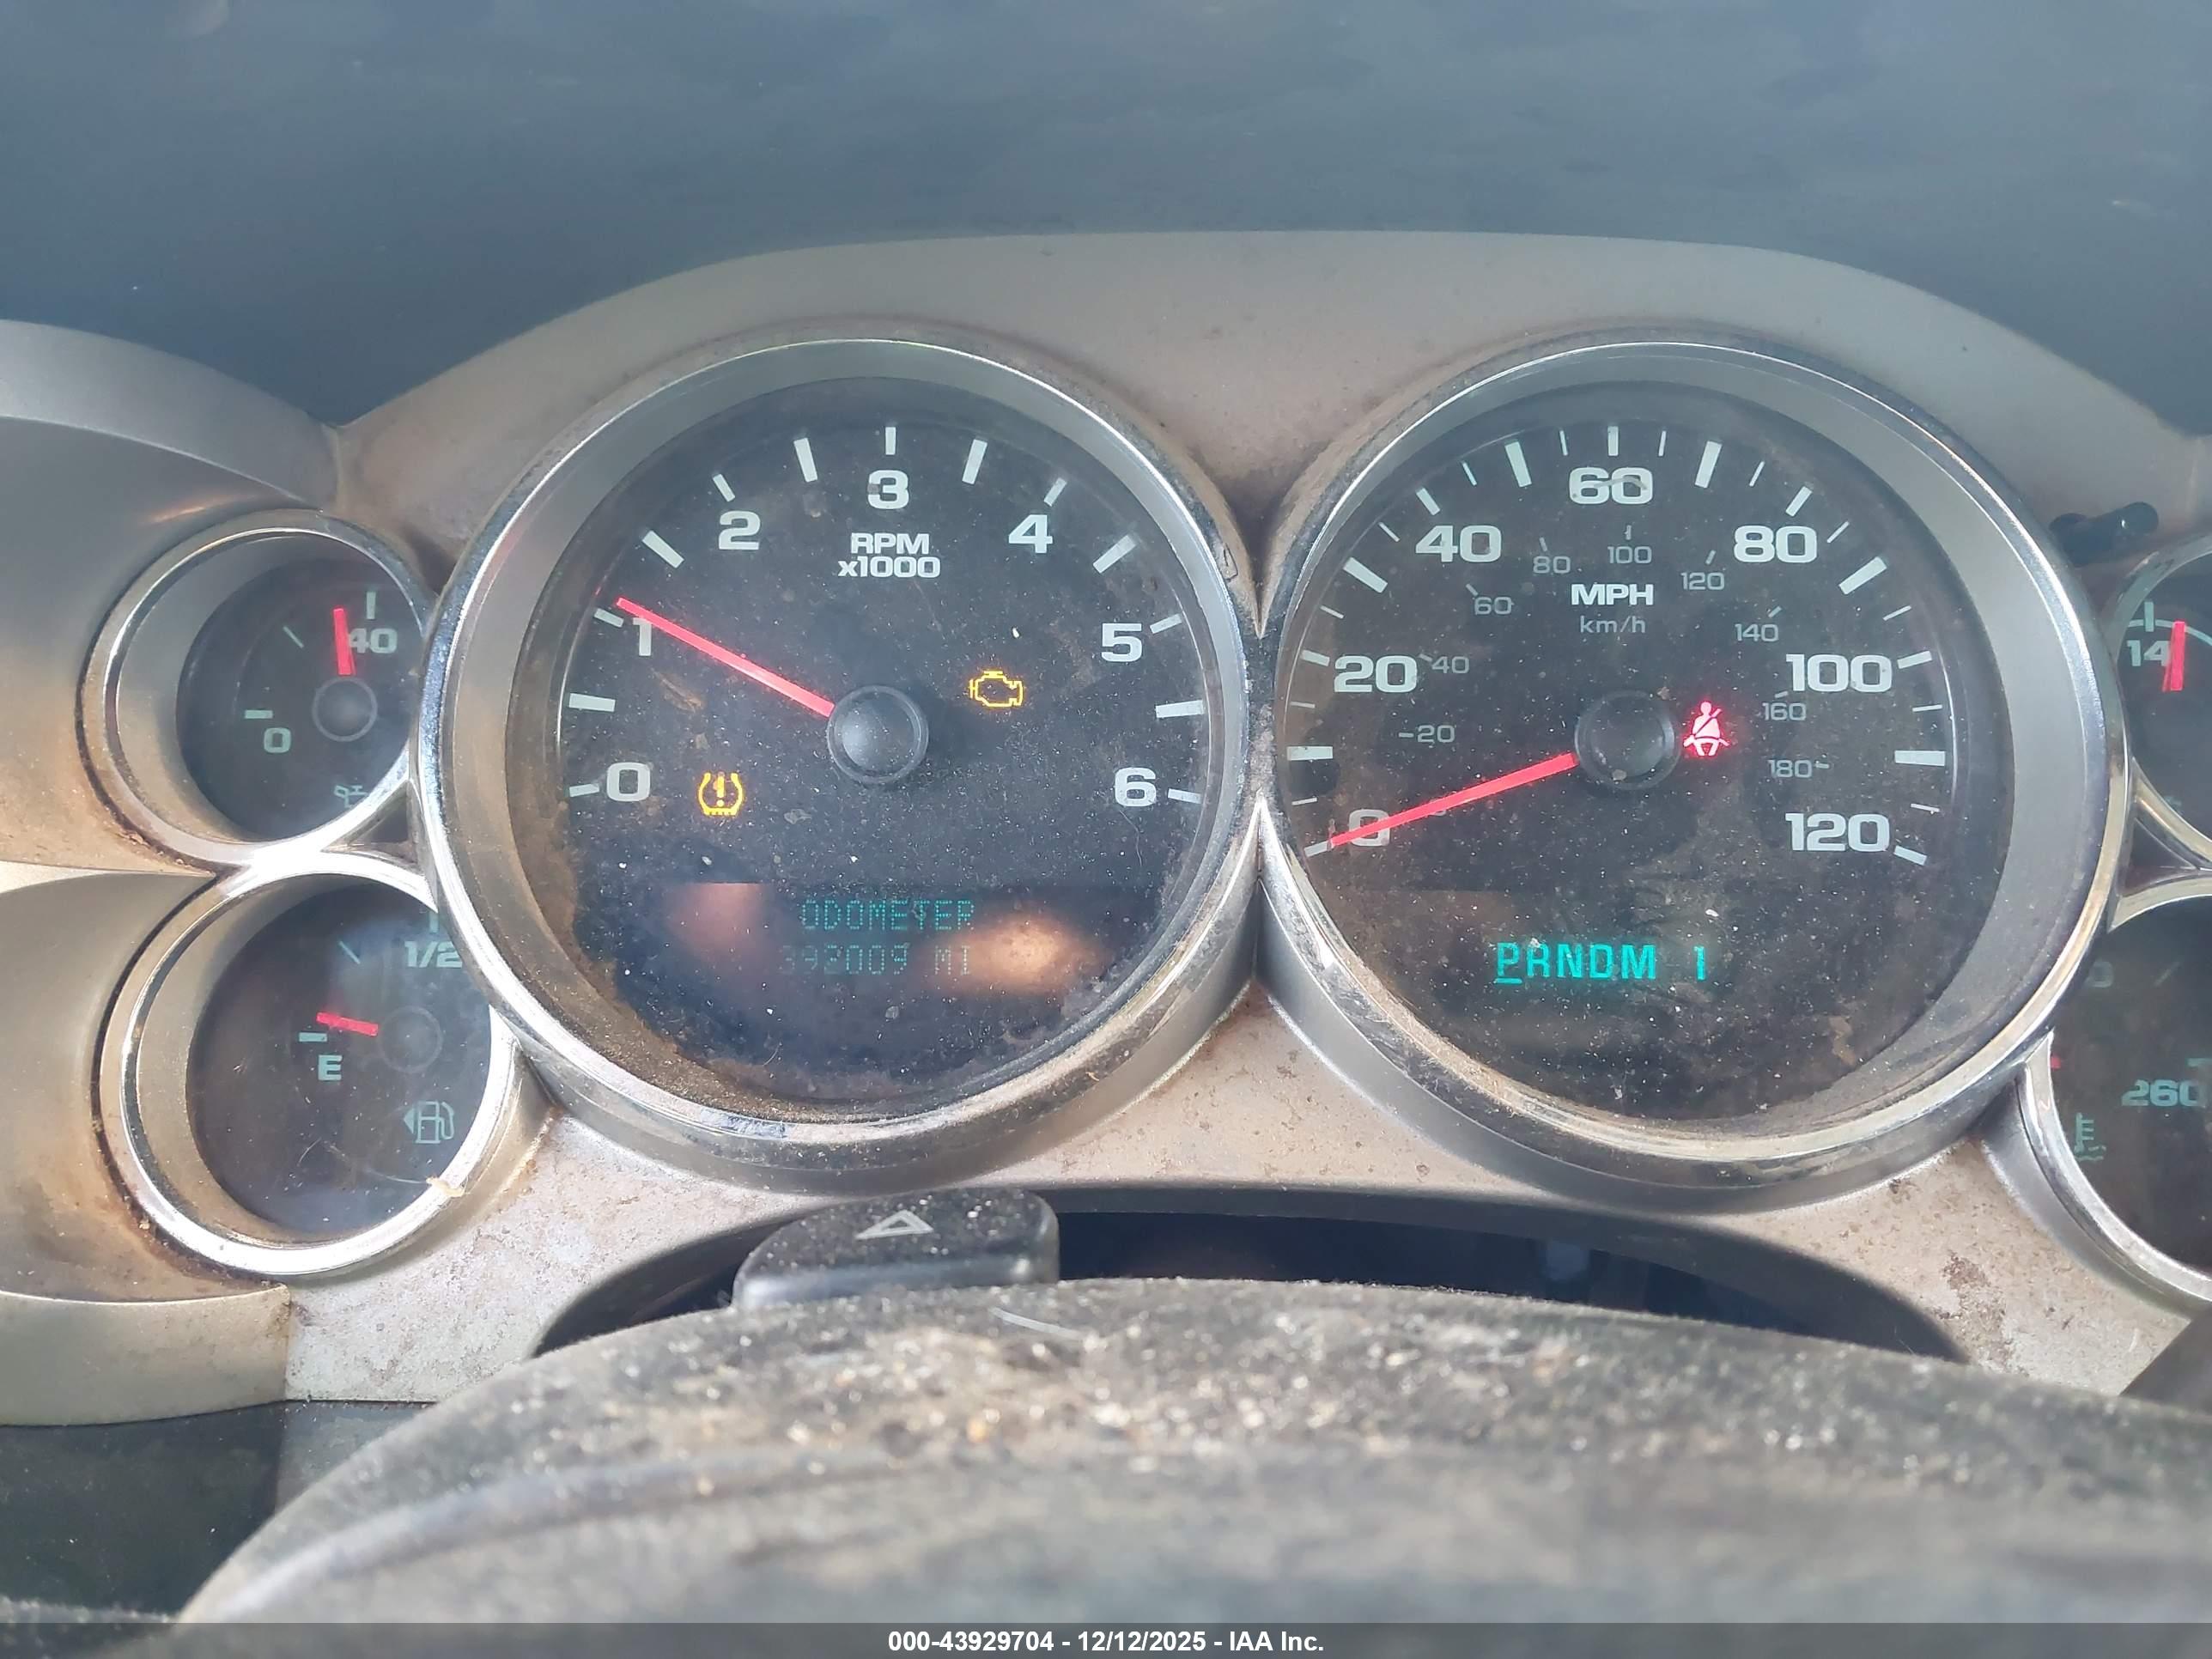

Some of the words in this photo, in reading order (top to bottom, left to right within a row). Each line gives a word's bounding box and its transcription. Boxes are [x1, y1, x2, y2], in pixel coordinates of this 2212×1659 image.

[867, 470, 909, 510] 3
[1569, 466, 1654, 505] 60
[719, 511, 760, 551] 2
[850, 532, 930, 556] RPM
[1008, 514, 1054, 554] 4
[1415, 525, 1502, 563] 40
[1733, 525, 1817, 563] 80
[837, 556, 940, 579] x1000
[1532, 556, 1571, 574] 80
[1607, 545, 1652, 565] 100
[1571, 583, 1654, 606] MPH
[1680, 572, 1725, 592] 120
[1474, 596, 1512, 616] 60
[632, 617, 653, 656] 1
[1580, 615, 1646, 635] km/h
[1735, 624, 1779, 643] 140
[348, 628, 398, 653] 40
[1101, 623, 1143, 663] 5
[2126, 640, 2170, 667] 14
[1334, 654, 1419, 693] 20
[1431, 655, 1470, 675] 40
[1786, 653, 1892, 693] 100
[1763, 702, 1807, 722] 160
[264, 727, 292, 754] 0
[1417, 726, 1455, 744] 20
[606, 763, 651, 802] 0
[1769, 759, 1813, 779] 180
[1115, 767, 1157, 807] 6
[1785, 812, 1890, 852] 120
[801, 898, 975, 932] ODOMETER
[404, 940, 463, 969] 1/2
[934, 945, 972, 976] MI
[1693, 945, 1705, 981] 1
[318, 1054, 343, 1082] E
[2121, 1079, 2202, 1108] 260
